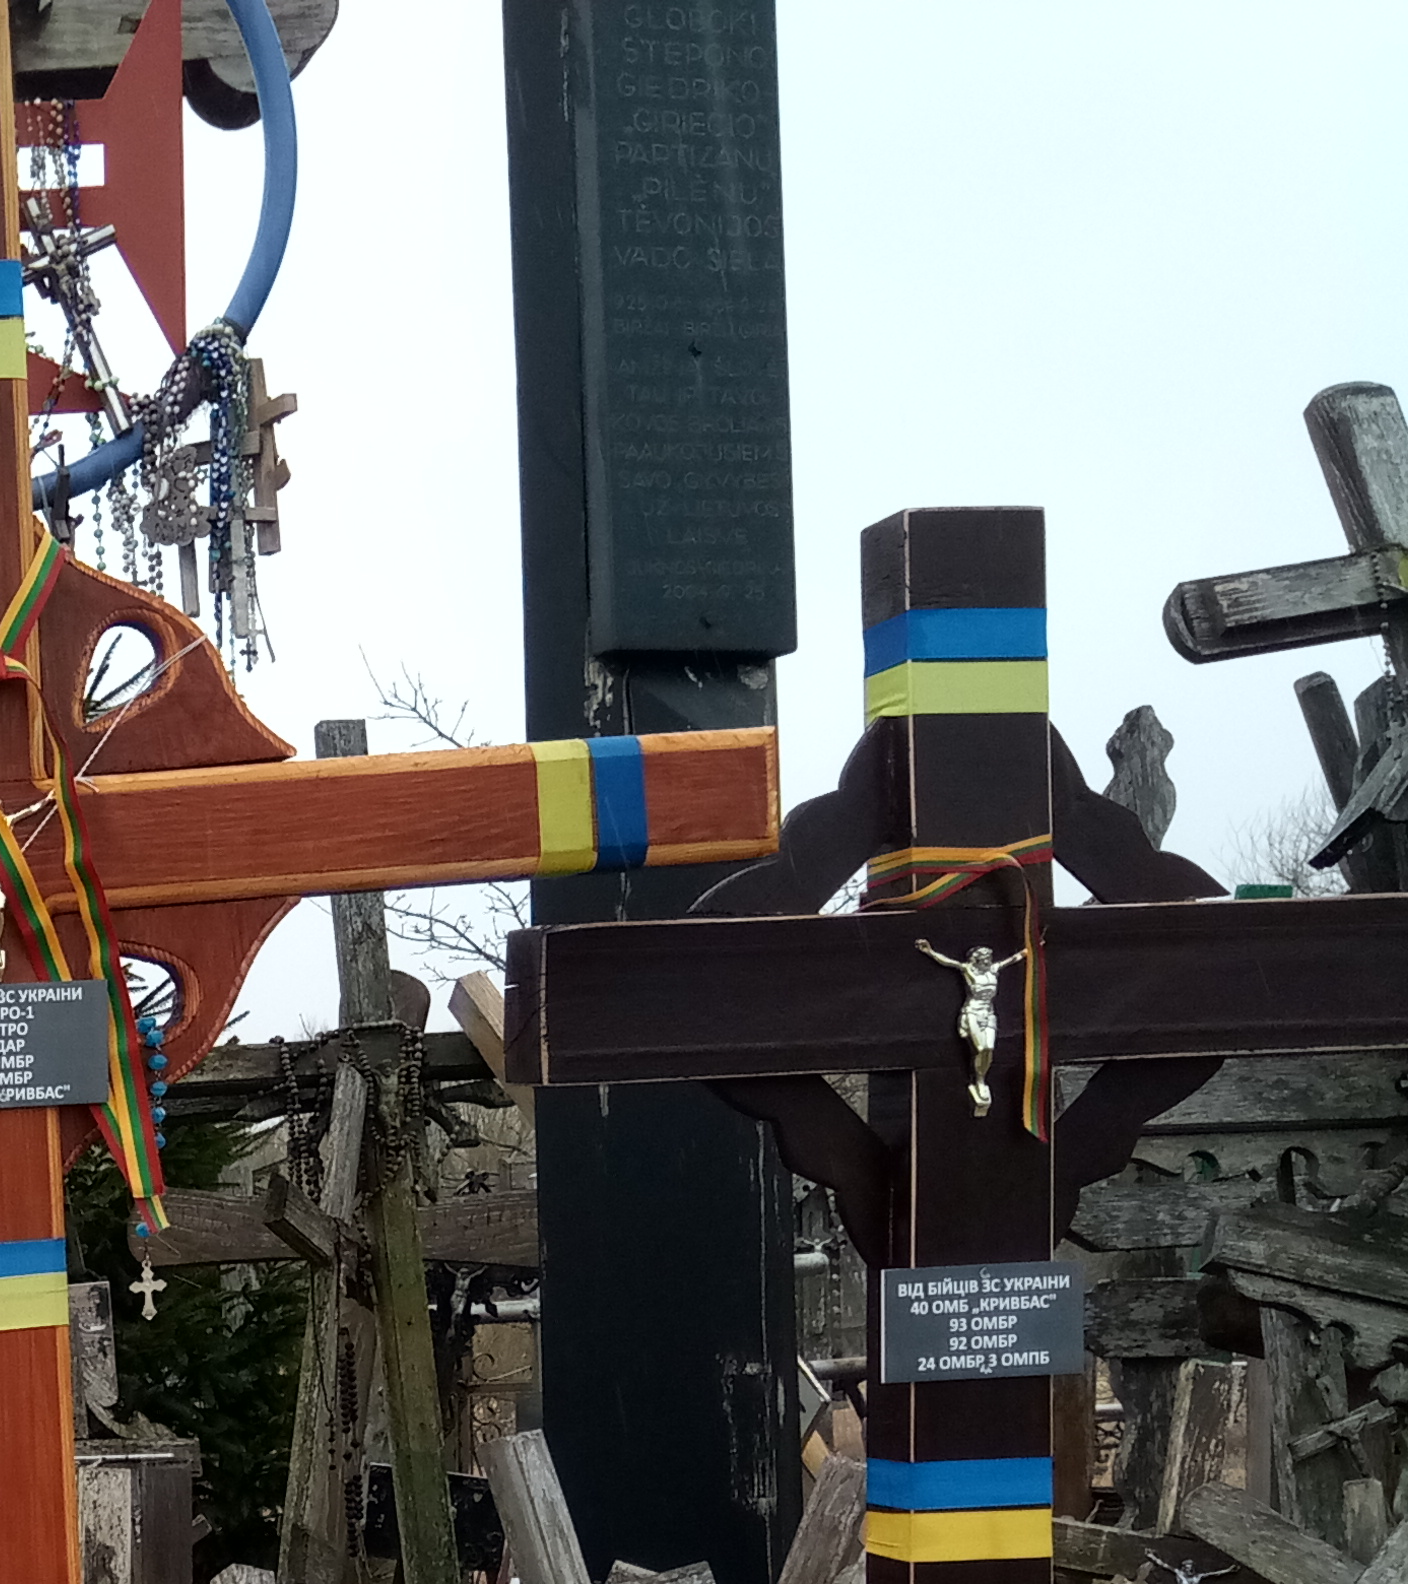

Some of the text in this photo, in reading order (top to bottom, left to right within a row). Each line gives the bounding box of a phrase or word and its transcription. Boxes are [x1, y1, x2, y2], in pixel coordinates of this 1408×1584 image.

[898, 1283, 925, 1299] ВІД
[928, 1279, 979, 1296] БІЙЦІВ
[982, 1279, 1002, 1293] ЗС
[910, 1301, 928, 1316] 40
[932, 1300, 969, 1314] ОМБ
[949, 1316, 1018, 1332] 93 ОМБР
[949, 1335, 1018, 1351] 92 ОМБР
[917, 1357, 936, 1371] 24
[1001, 1352, 1050, 1366] ОМПБ
